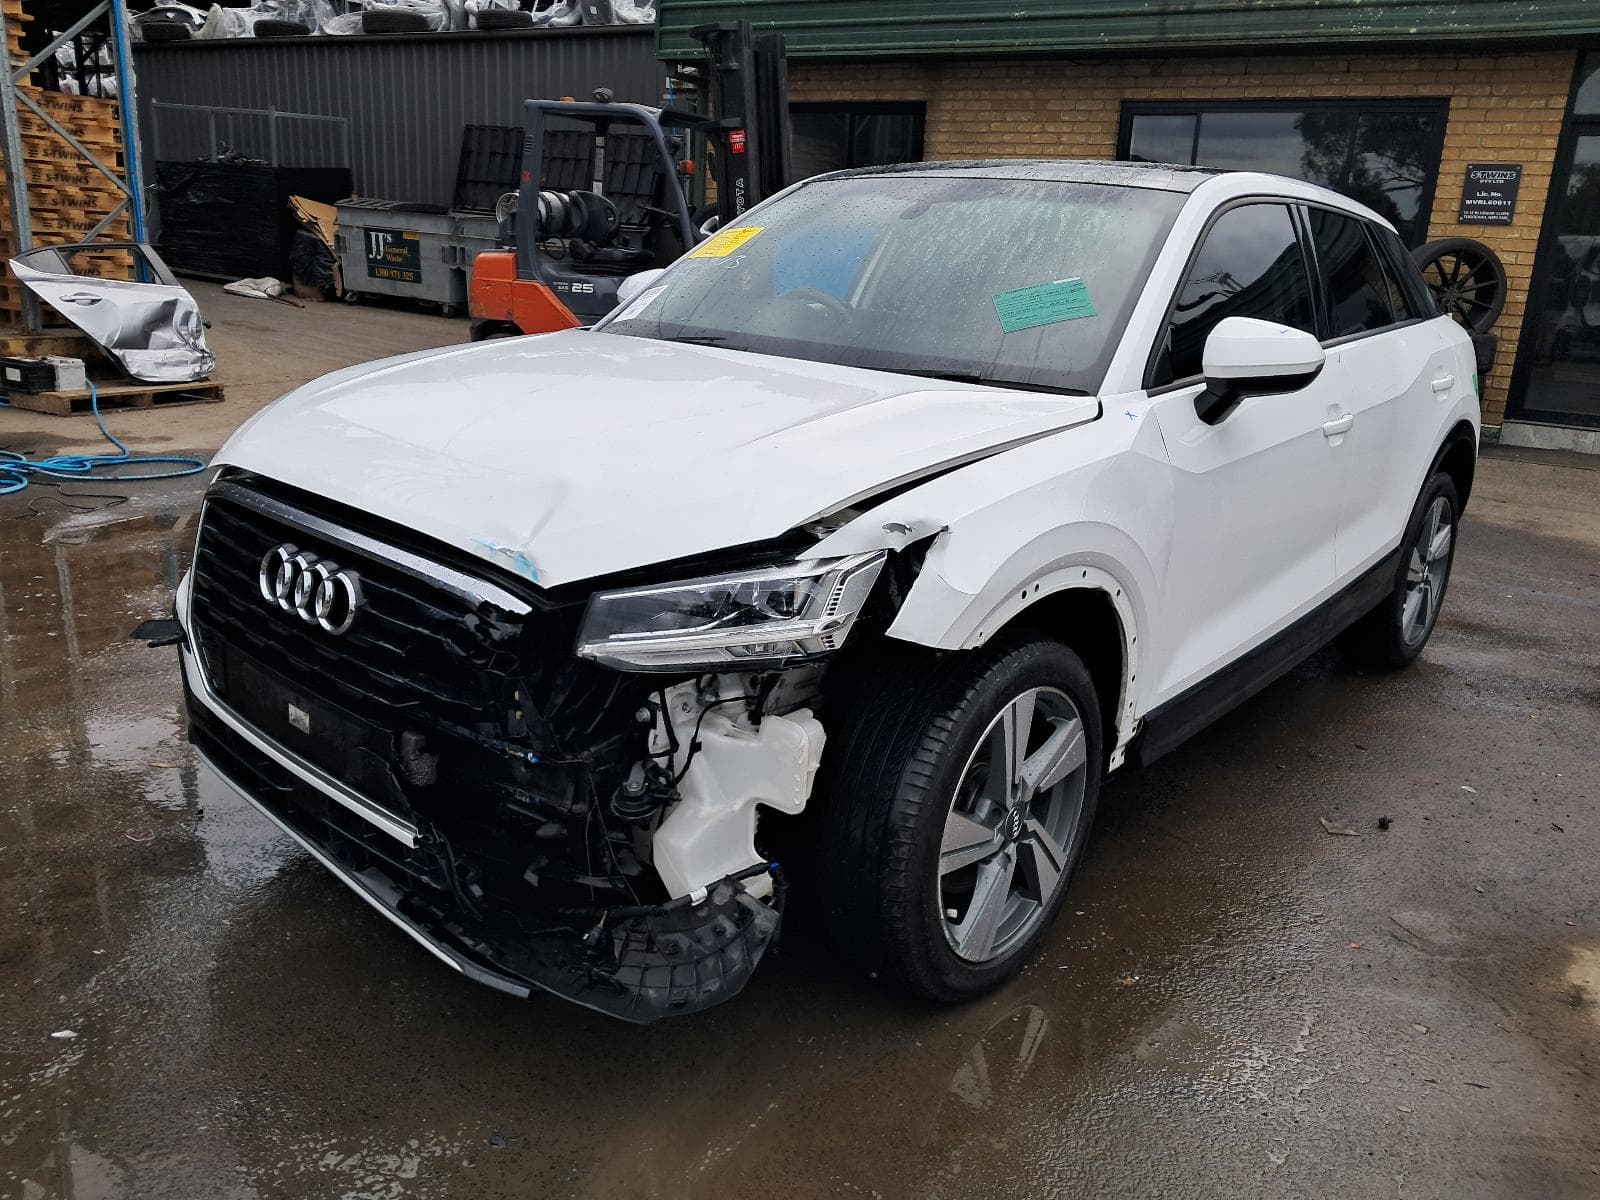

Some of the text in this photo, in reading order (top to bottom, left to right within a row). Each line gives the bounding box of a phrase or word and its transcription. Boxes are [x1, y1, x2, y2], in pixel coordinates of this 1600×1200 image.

[36, 99, 83, 112] S-TWINS
[46, 172, 89, 185] S-TWINS
[735, 177, 745, 215] YOTA
[571, 282, 594, 294] 25
